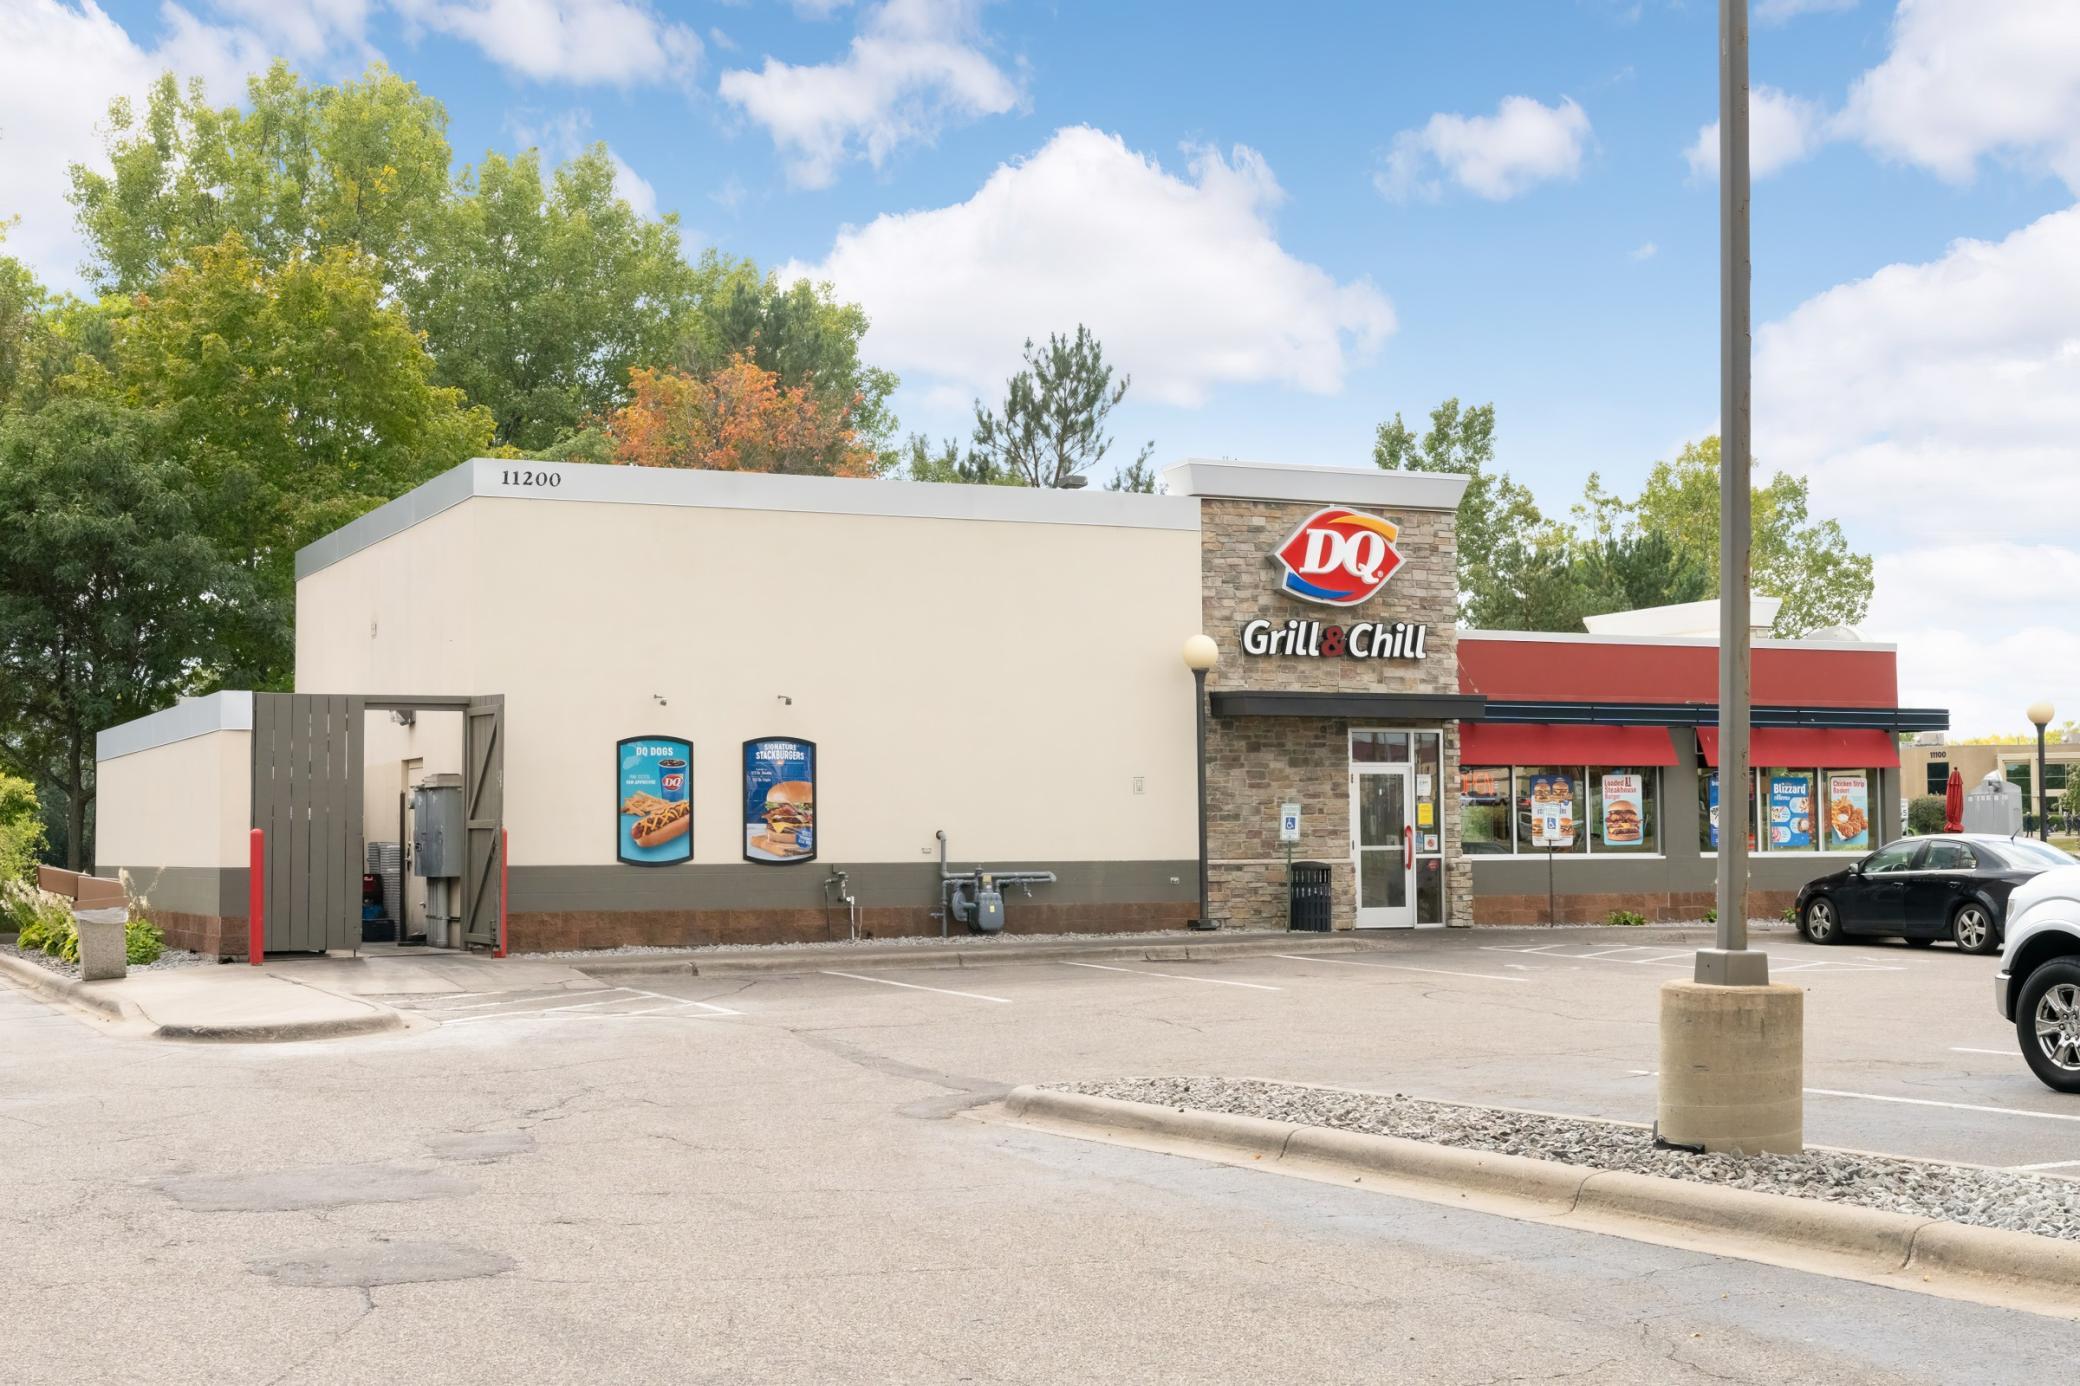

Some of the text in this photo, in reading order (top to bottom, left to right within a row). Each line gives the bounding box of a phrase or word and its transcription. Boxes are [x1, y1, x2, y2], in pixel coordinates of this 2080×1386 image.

[501, 469, 562, 487] 11200
[1298, 528, 1386, 584] DQ
[1243, 619, 1320, 657] Grill
[1349, 621, 1427, 659] Chill
[636, 747, 674, 757] DQ DOGS
[755, 750, 805, 760] STACKBURGERS
[1604, 778, 1625, 787] Loaded
[1773, 783, 1807, 795] Blizzard
